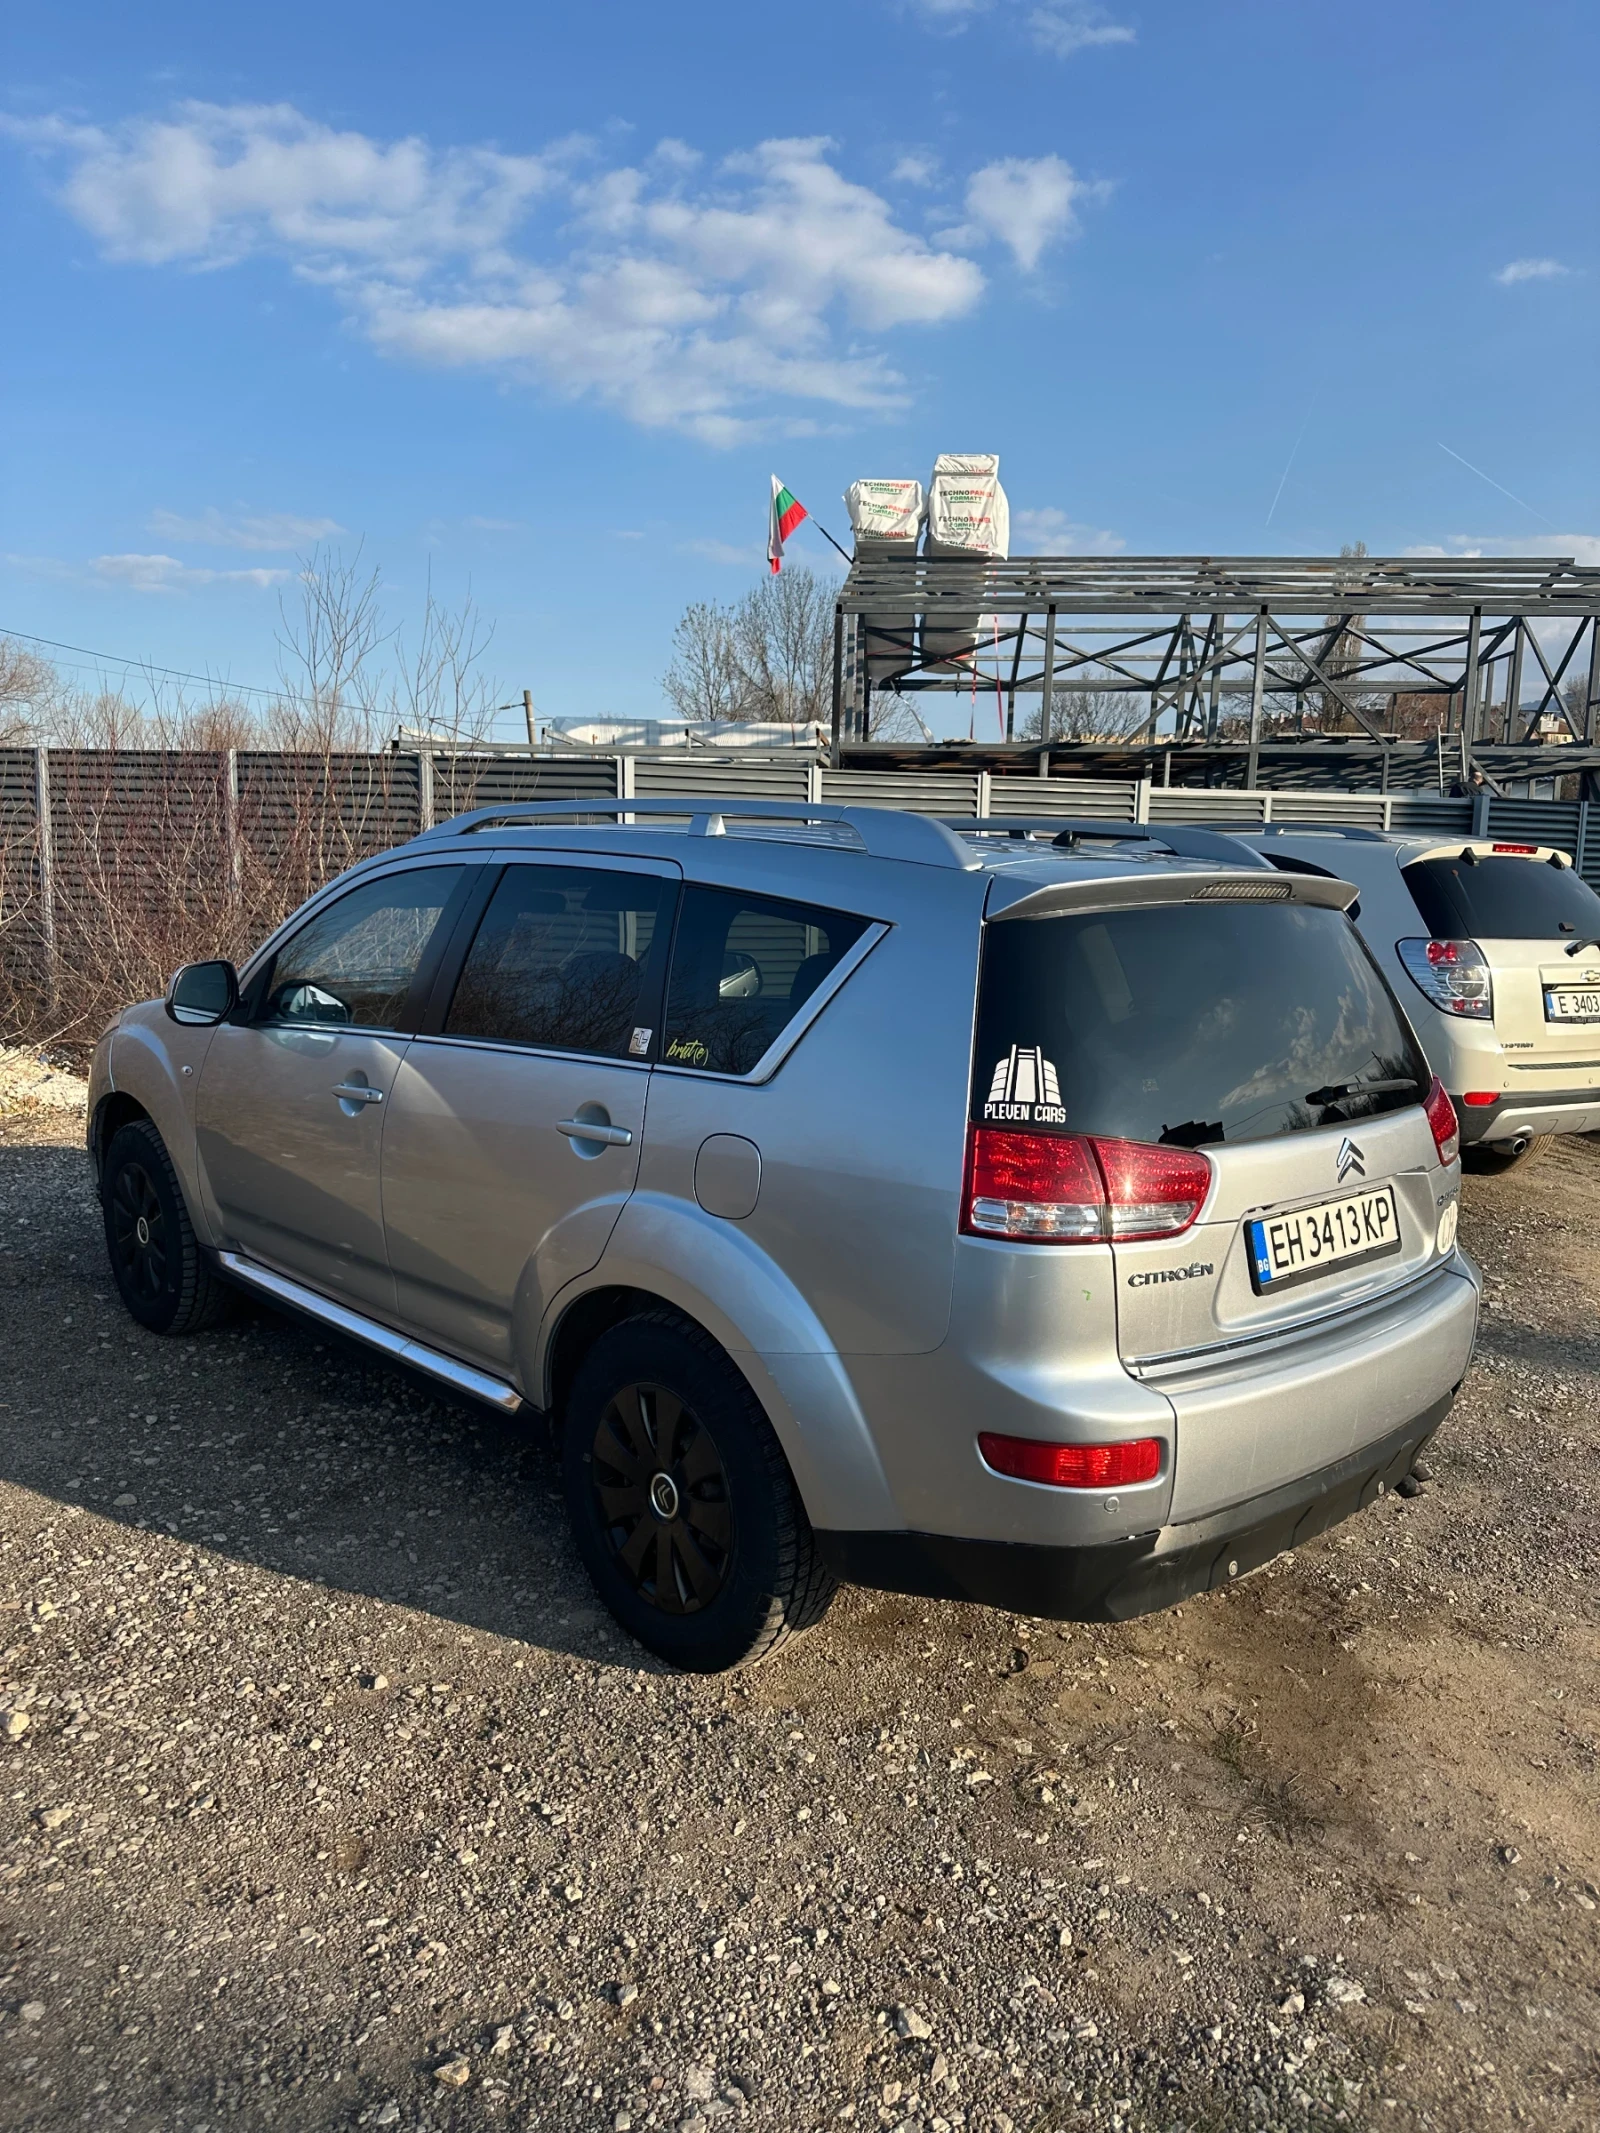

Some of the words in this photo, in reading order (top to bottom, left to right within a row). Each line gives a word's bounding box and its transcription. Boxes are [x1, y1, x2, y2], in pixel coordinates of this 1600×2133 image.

[939, 490, 994, 498] TECHNOPANEL
[858, 500, 913, 514] TECHNOPANEL
[868, 508, 900, 518] FORMATT
[984, 1103, 1030, 1121] PLEVEN
[1034, 1105, 1067, 1123] CARS
[1442, 1204, 1455, 1248] CH
[1257, 1259, 1270, 1273] BG
[1127, 1262, 1214, 1288] CITROËN
